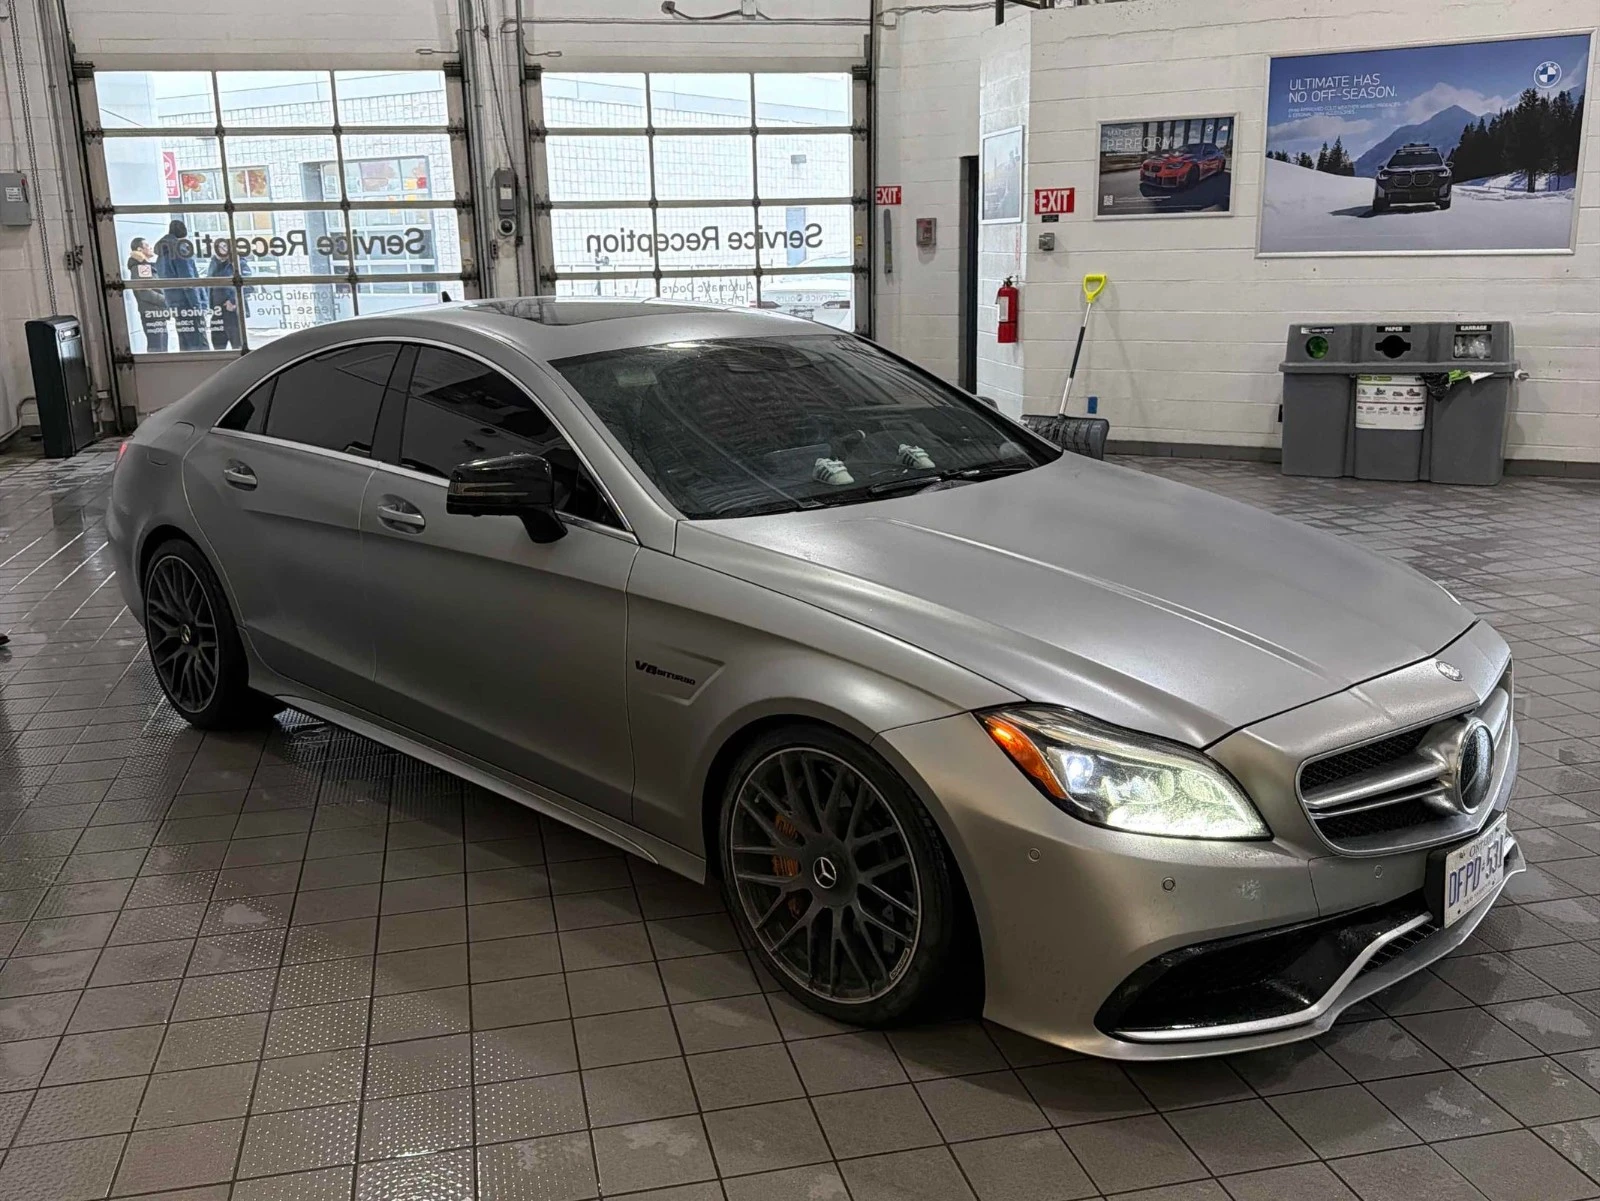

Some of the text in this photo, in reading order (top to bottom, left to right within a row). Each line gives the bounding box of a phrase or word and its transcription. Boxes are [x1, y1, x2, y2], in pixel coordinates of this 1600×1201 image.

[1289, 73, 1381, 91] ULTIMATE HAS
[1288, 86, 1398, 104] NO OFF-SEASON.
[1107, 128, 1140, 137] MADE TO
[1106, 136, 1174, 150] PERFORM
[876, 187, 898, 204] EXIT
[1039, 190, 1070, 212] EXIT
[635, 660, 696, 685] V8 BITURBO
